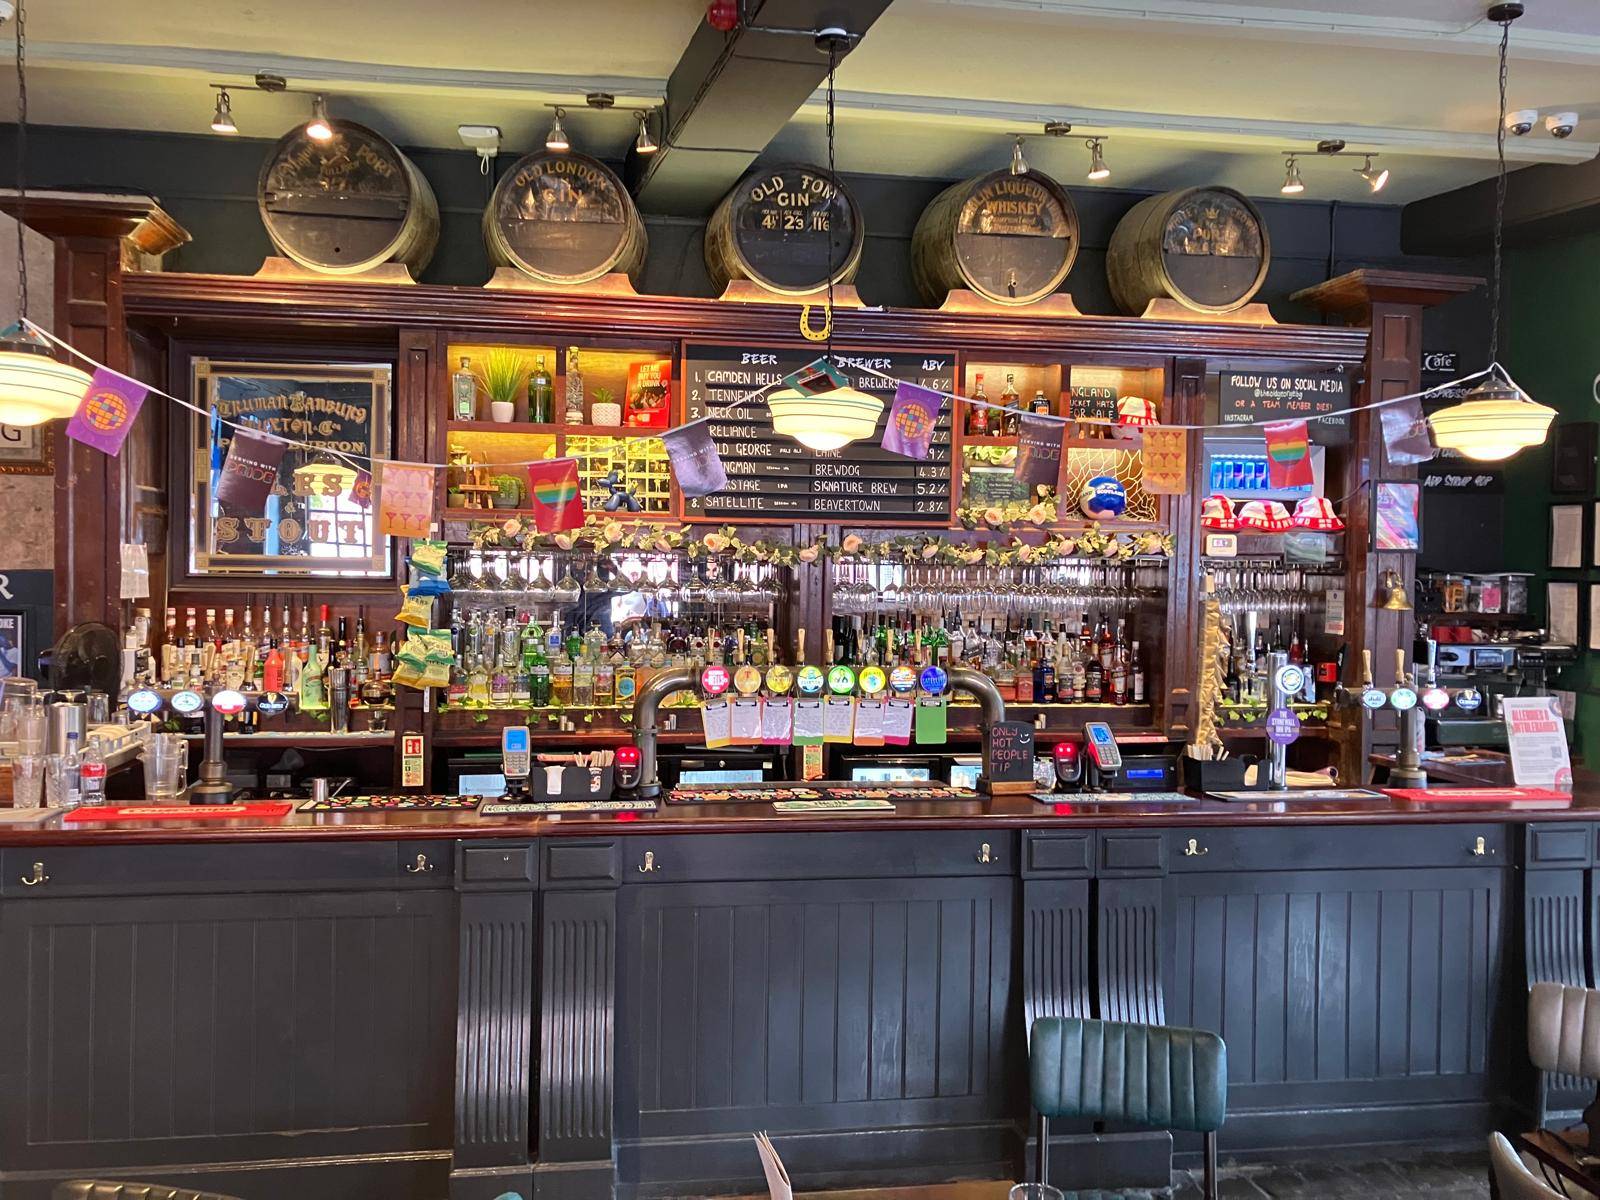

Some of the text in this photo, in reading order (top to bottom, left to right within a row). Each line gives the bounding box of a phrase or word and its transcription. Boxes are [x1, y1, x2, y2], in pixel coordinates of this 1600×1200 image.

[514, 161, 607, 190] OLD LONDON
[752, 175, 837, 201] OLD TOM
[995, 181, 1048, 203] LIQUEUR
[543, 189, 585, 203] GIN
[778, 192, 810, 207] GIN
[986, 201, 1042, 215] WHISKEY
[741, 353, 778, 365] BEER
[837, 357, 891, 369] BREWER
[922, 360, 946, 371] ABV
[708, 370, 751, 384] CAMDEN
[756, 373, 782, 385] HELLS
[1231, 375, 1344, 393] FOLLOW US ON SOCIAL MEDIA
[1071, 387, 1111, 398] NGLAND
[1097, 400, 1115, 408] HATS
[1235, 400, 1245, 408] OR
[1262, 400, 1280, 409] TEAM
[1287, 401, 1311, 411] MEMBER
[708, 407, 732, 419] NECK
[737, 408, 753, 419] OIL
[1091, 409, 1114, 419] SALE
[1224, 414, 1254, 422] INSTAGRAM
[1317, 416, 1345, 425] FACEBOOK
[709, 425, 757, 438] RELIANCE
[717, 444, 729, 455] LD
[736, 443, 772, 455] GEORGE
[926, 449, 944, 460] .9%
[230, 455, 277, 471] SERVING WITH
[723, 461, 756, 473] NGMAN
[815, 464, 860, 476] BREWDOG
[919, 467, 946, 478] 4.3%
[726, 480, 760, 491] KSTAGE
[814, 481, 898, 494] SIGNATURE BREW
[917, 483, 946, 495] 5.2%
[705, 496, 765, 509] SATELLITE
[814, 499, 880, 511] BEAVERTOWN
[917, 501, 943, 513] 2.8%
[217, 517, 364, 543] STOUT
[992, 727, 1018, 737] ONLY
[992, 738, 1013, 748] HOT
[992, 749, 1028, 760] PEOPLE
[990, 762, 1010, 772] TIP
